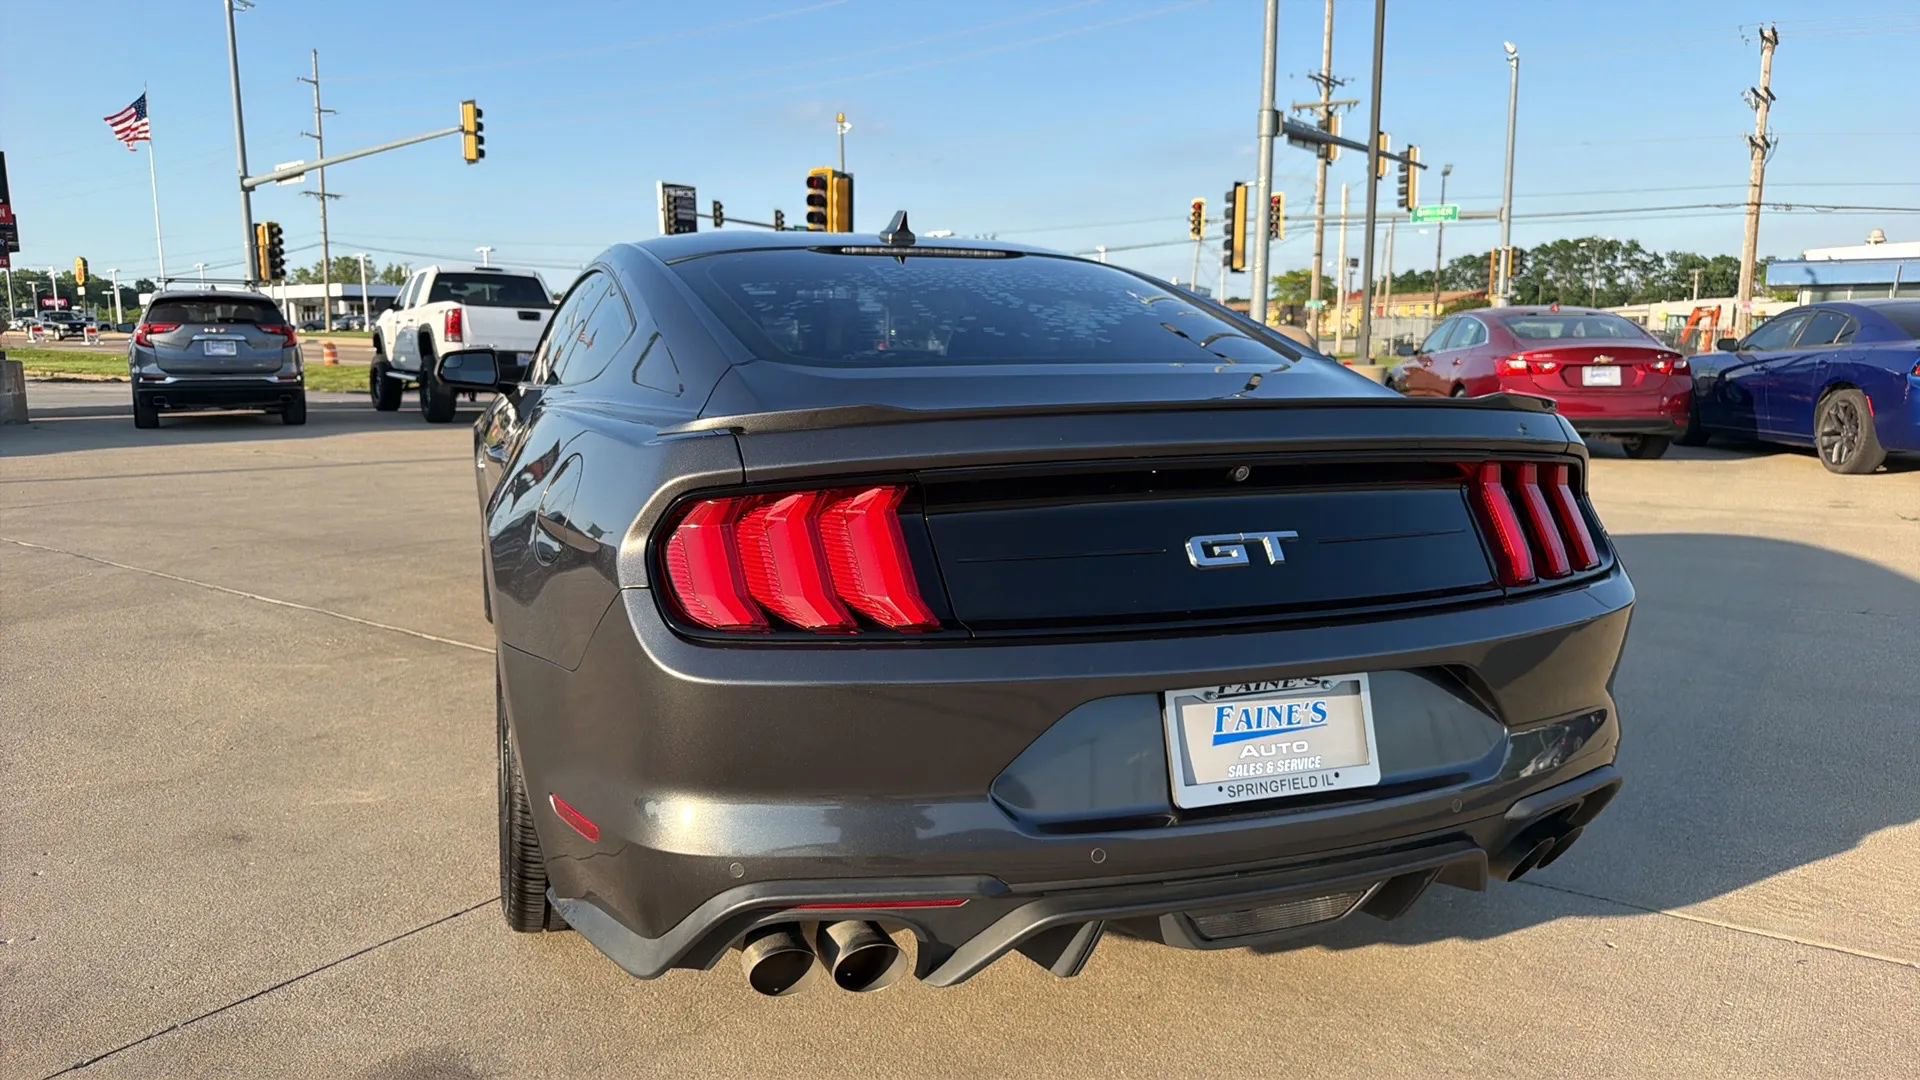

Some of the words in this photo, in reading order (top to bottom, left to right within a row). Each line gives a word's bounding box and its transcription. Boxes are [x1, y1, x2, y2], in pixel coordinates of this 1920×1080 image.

[1185, 530, 1299, 570] GT
[1214, 700, 1328, 733] FAINE'S
[1239, 739, 1309, 759] AUTO
[1227, 762, 1265, 778] SALES
[1266, 761, 1275, 774] &
[1277, 755, 1322, 773] SERVICE
[1227, 775, 1319, 798] SPRINGFIELD
[1321, 774, 1334, 787] IL
